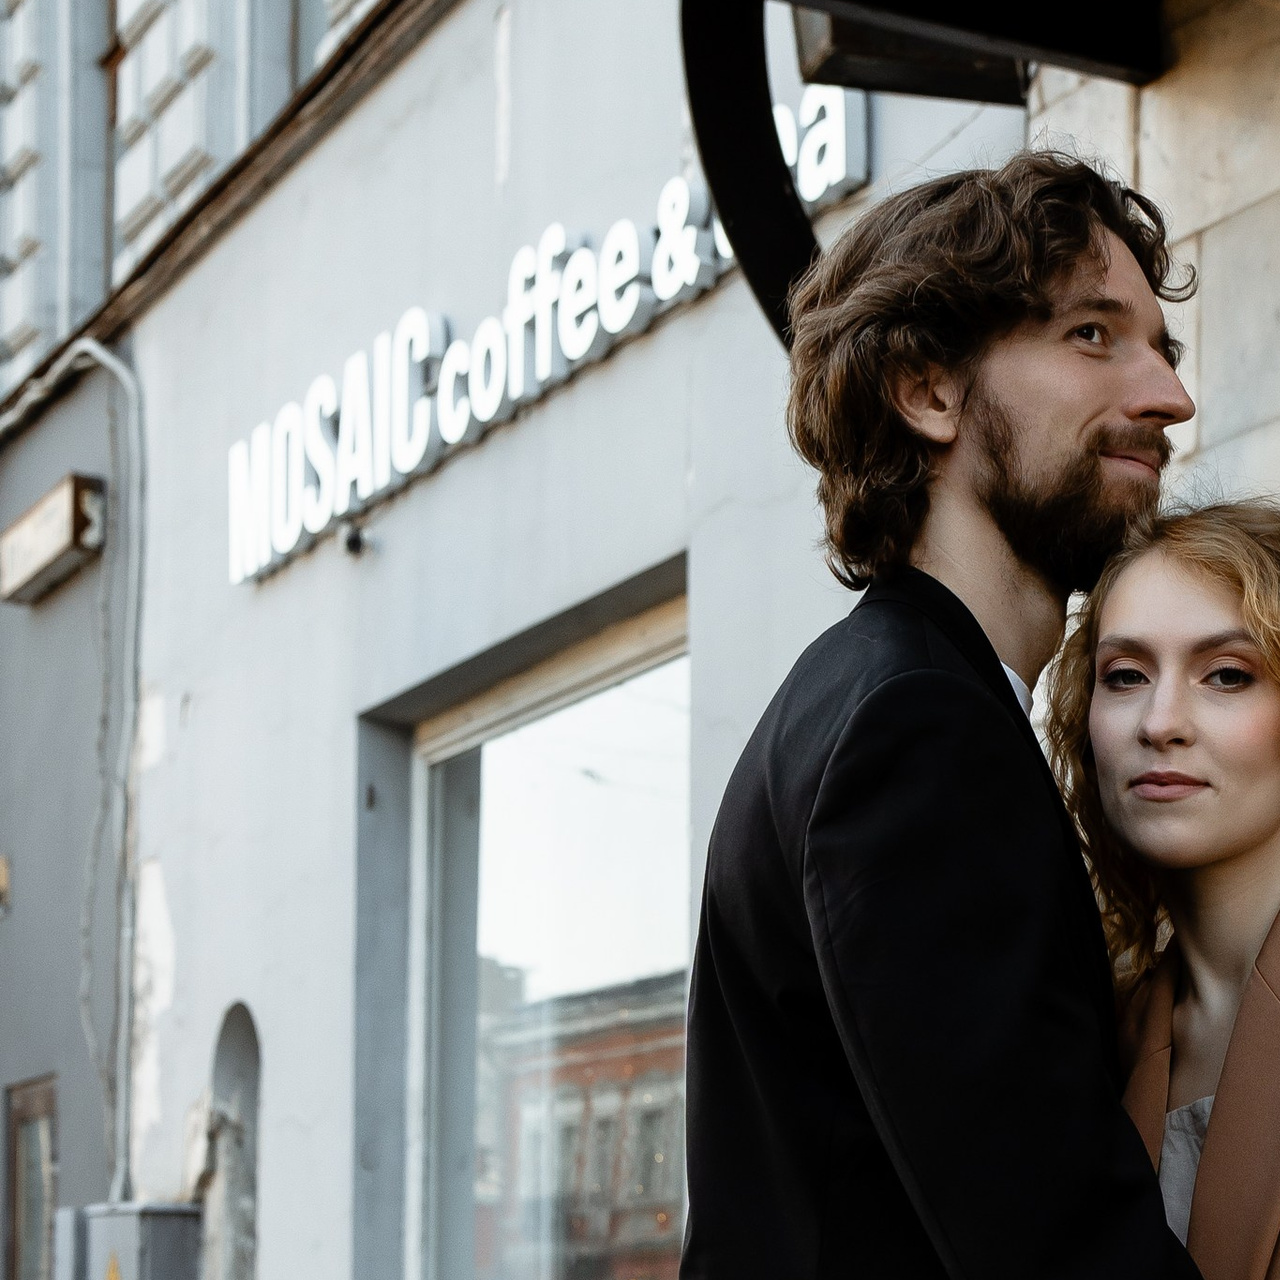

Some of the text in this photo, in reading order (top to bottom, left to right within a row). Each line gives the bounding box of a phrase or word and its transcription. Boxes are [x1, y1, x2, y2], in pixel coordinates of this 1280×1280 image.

[227, 176, 700, 585] MOSAIC coffee &
